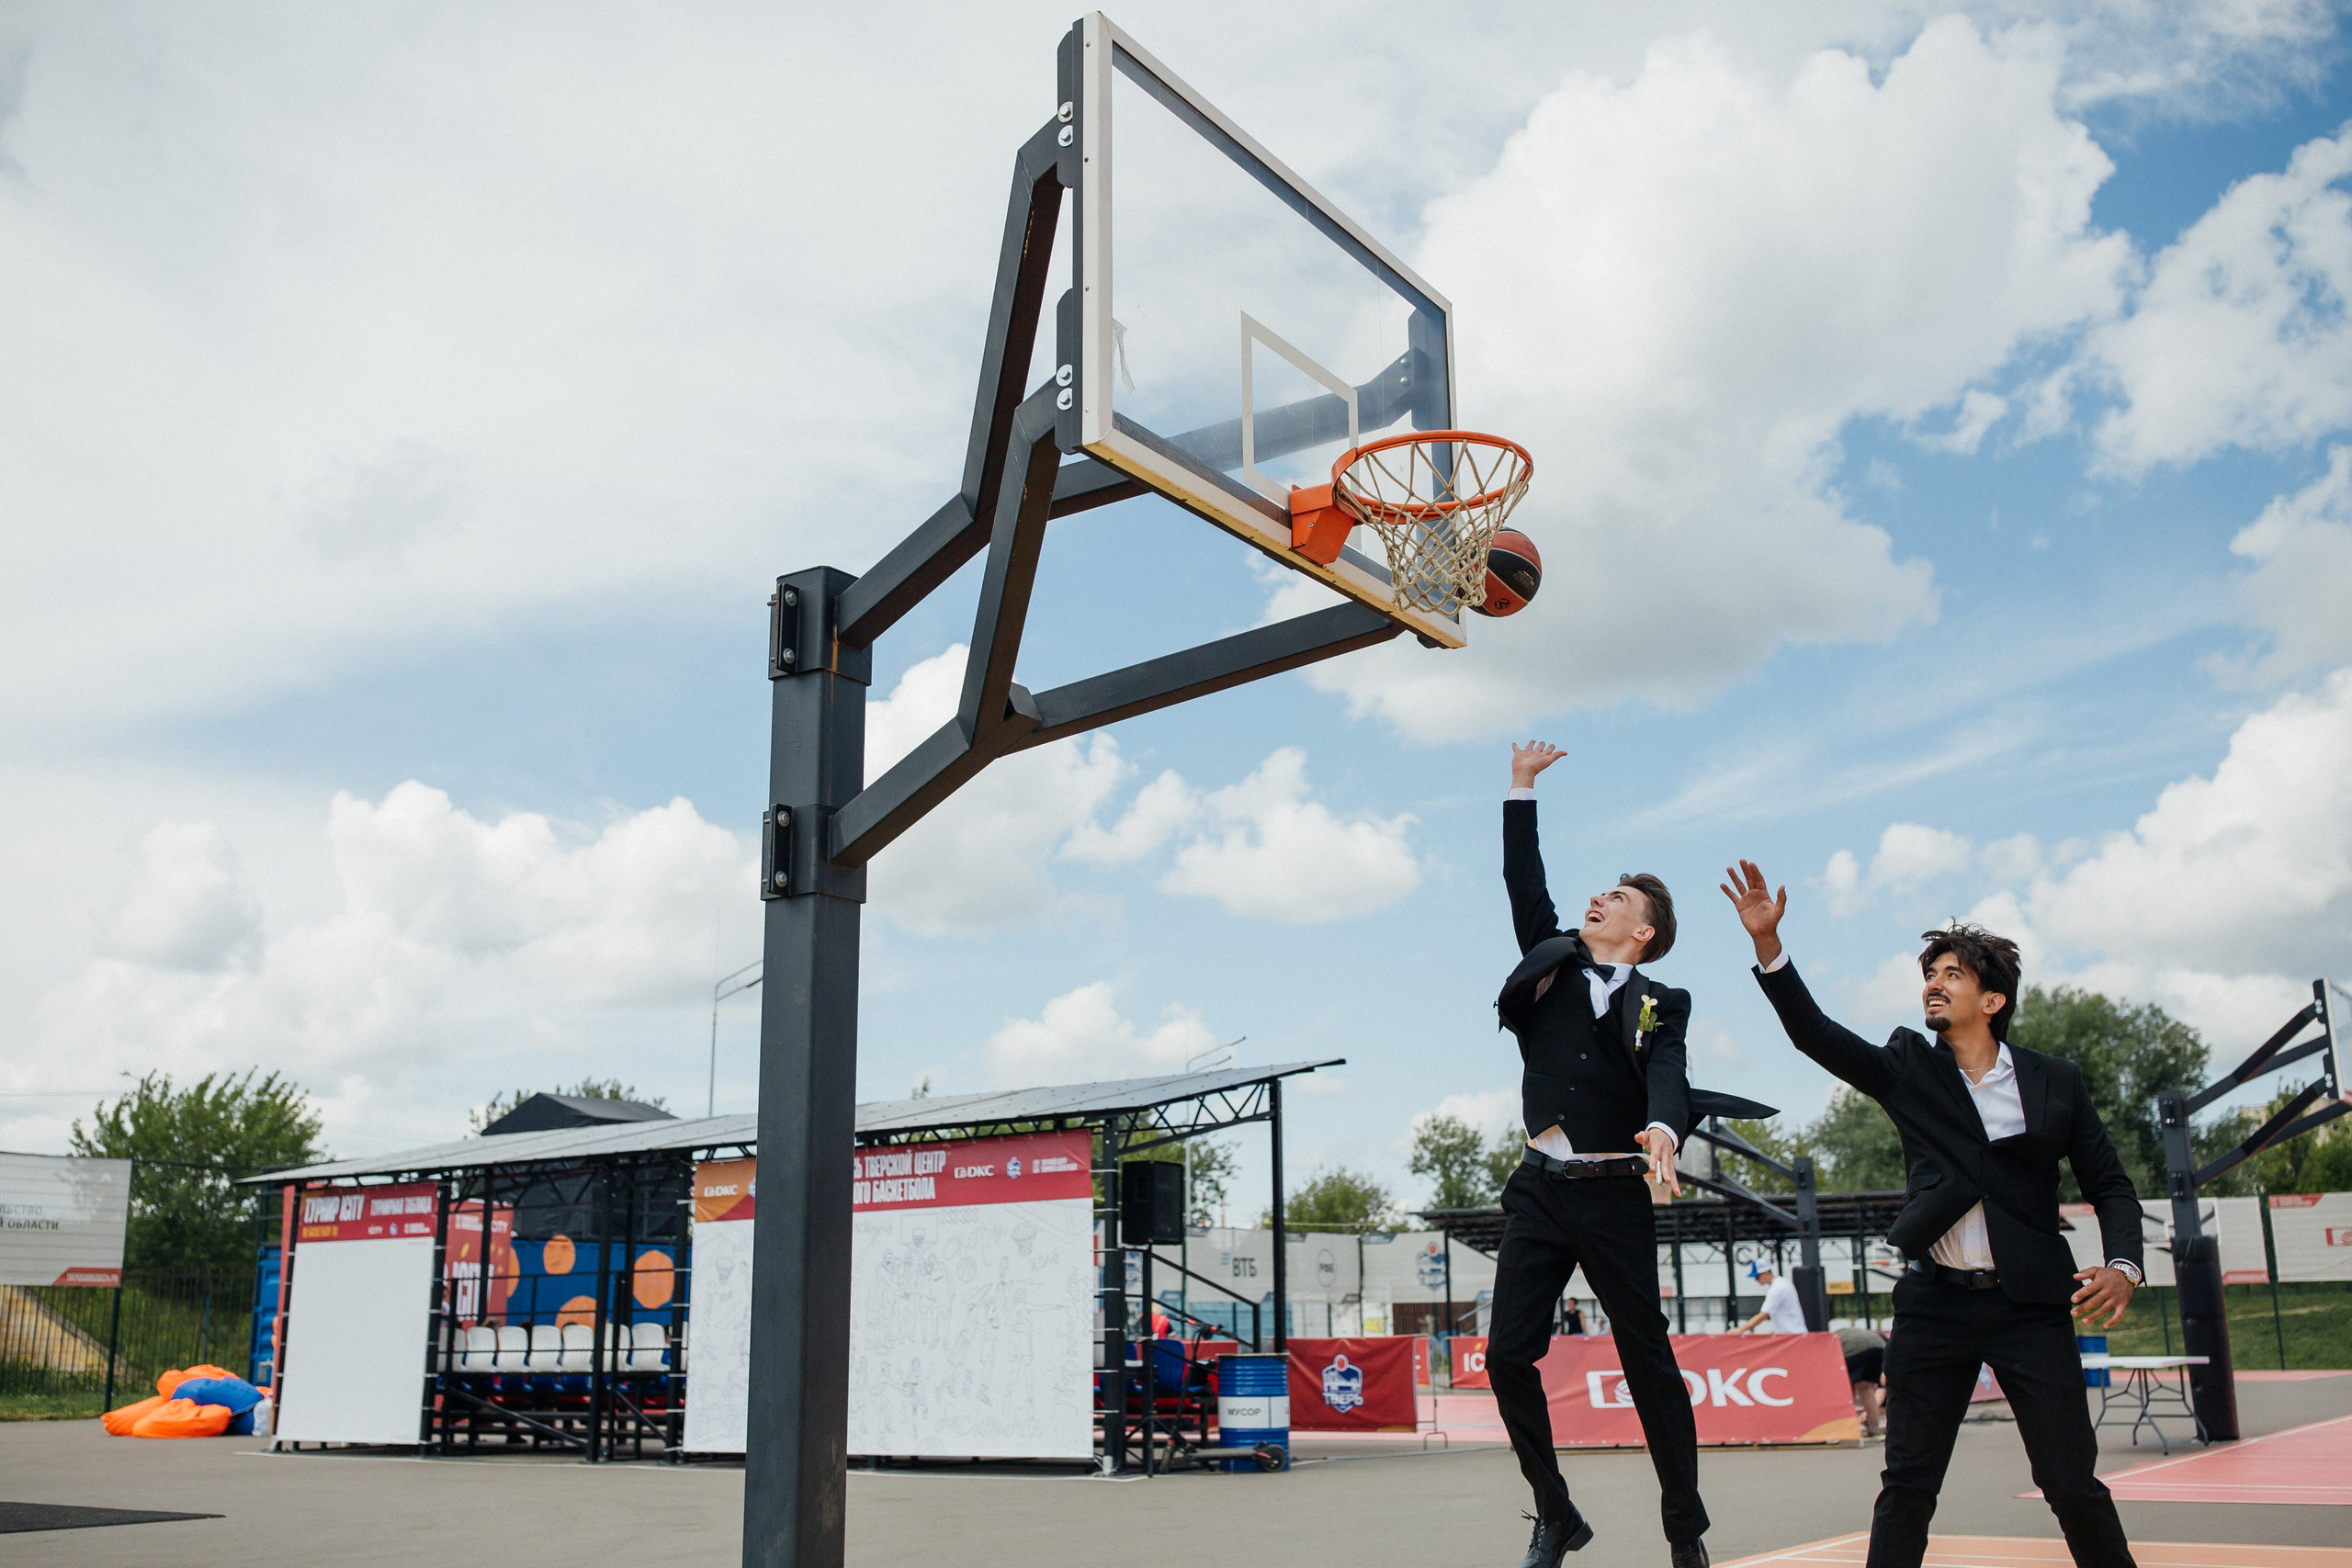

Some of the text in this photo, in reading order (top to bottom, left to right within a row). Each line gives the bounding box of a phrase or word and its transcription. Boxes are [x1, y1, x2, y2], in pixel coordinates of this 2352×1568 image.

[865, 1149, 912, 1179] ТВЕРСКОЙ
[914, 1150, 946, 1176] ЦЕНТР
[872, 1177, 936, 1203] БАСКЕТБОЛА
[7, 1218, 59, 1231] ОБЛАСТИ
[1233, 1258, 1257, 1277] ВТБ
[1227, 1408, 1261, 1416] МУСОР
